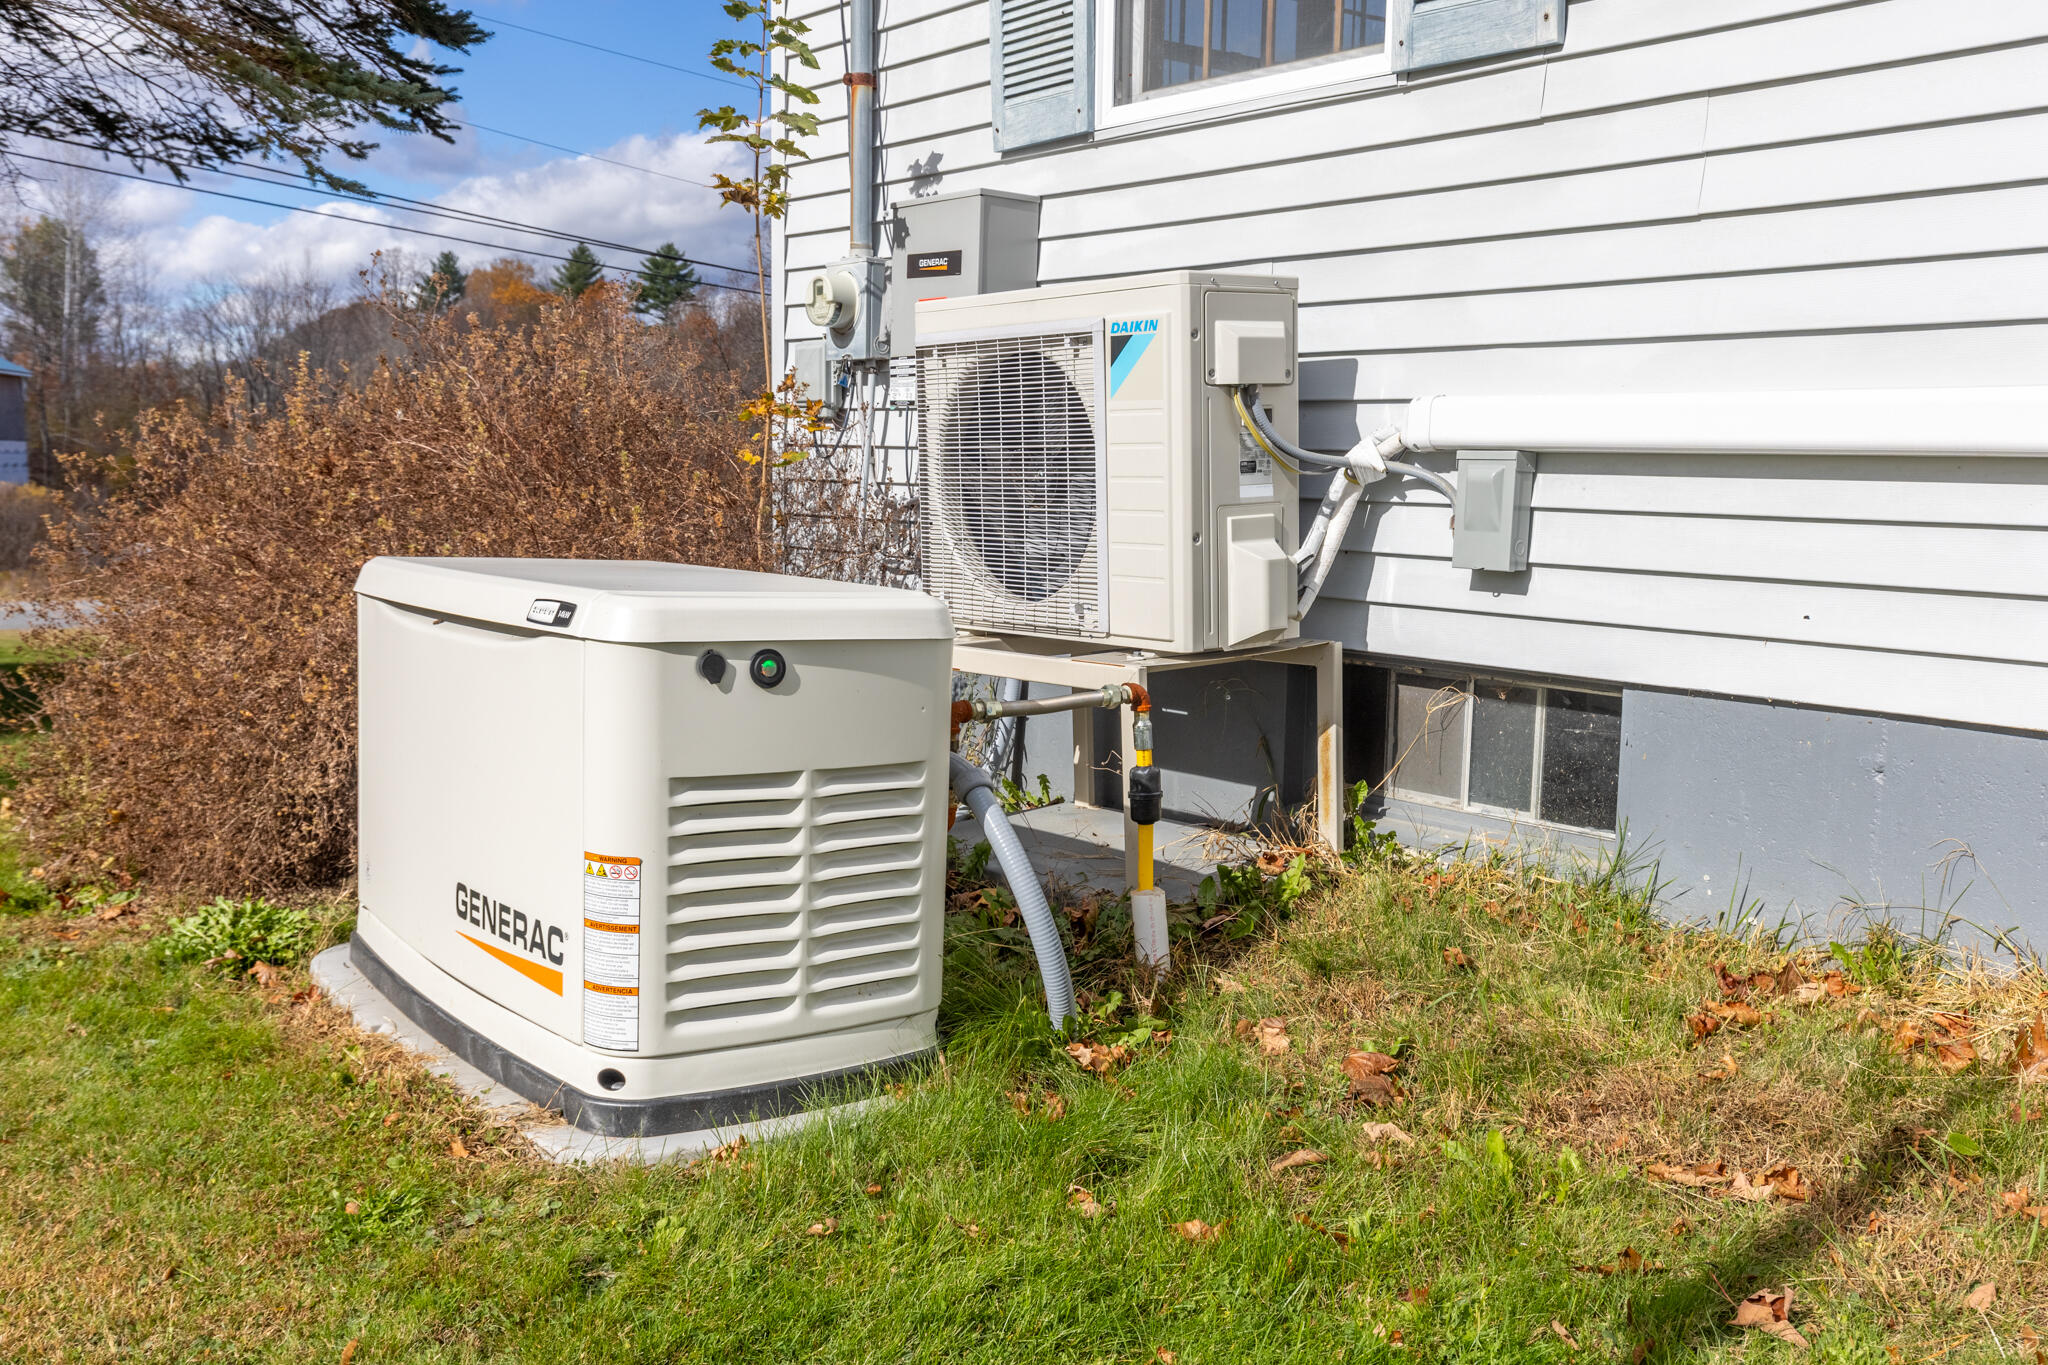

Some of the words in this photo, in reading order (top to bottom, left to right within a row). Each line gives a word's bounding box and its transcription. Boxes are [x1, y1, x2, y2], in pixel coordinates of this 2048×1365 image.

[919, 258, 948, 267] GENERAC
[1110, 319, 1159, 334] DAIKIN
[599, 856, 628, 864] WARNING
[456, 882, 564, 966] GENERAC
[590, 921, 637, 932] AVERTISSEMENT
[592, 984, 633, 994] ADVERTENCIA
